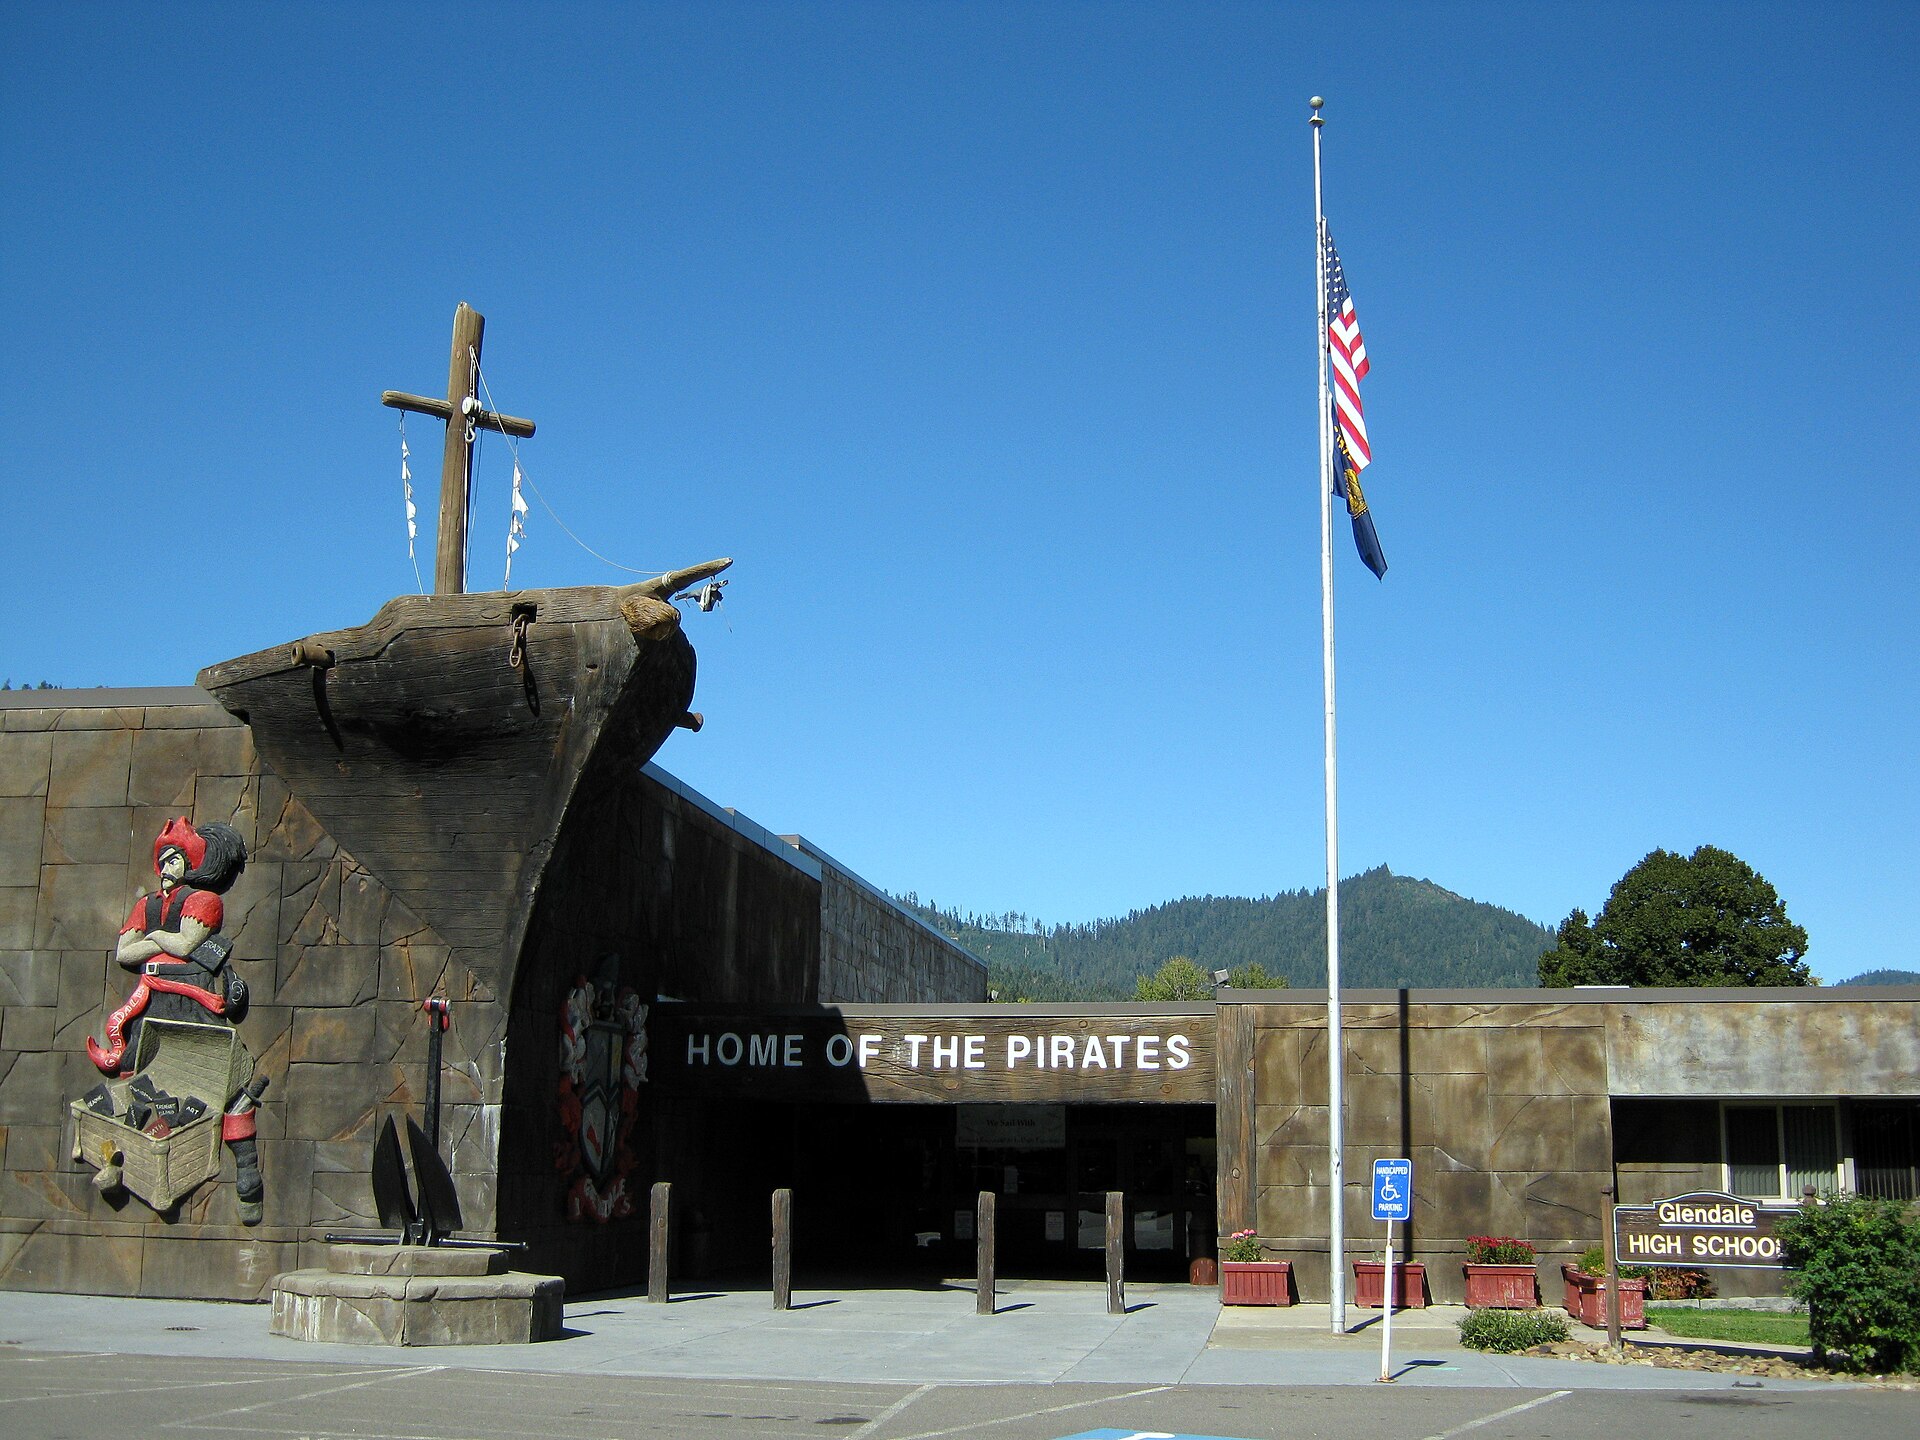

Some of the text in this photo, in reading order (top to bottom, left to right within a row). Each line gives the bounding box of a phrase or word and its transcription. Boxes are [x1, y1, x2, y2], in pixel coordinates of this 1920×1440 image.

[104, 985, 145, 1068] GLENDALE
[687, 1032, 1191, 1069] HOME OF THE PIRATES
[1378, 1203, 1402, 1211] PARKING
[1658, 1203, 1755, 1224] Glendale
[1628, 1234, 1682, 1254] HIGH
